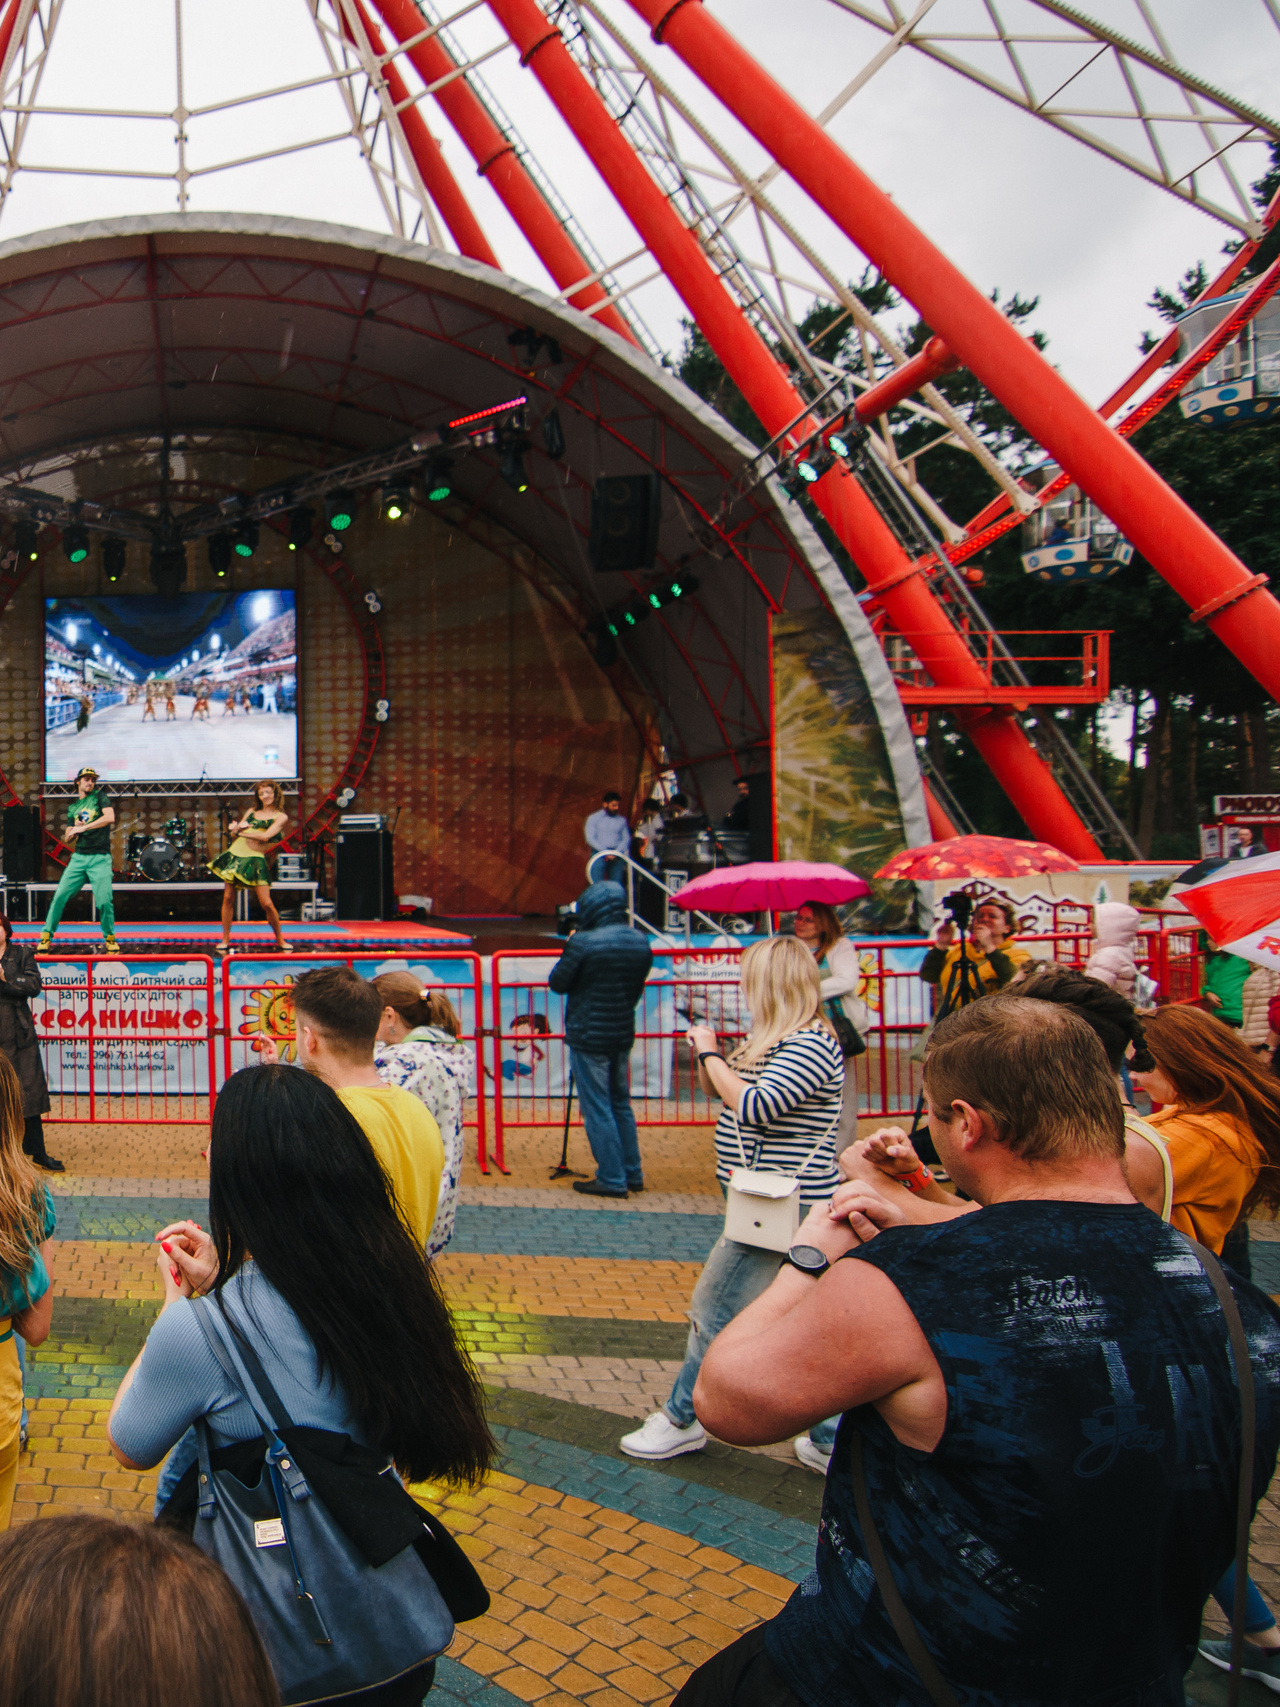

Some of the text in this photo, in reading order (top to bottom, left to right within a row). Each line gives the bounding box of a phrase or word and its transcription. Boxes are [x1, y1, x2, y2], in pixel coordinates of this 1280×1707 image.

[40, 974, 87, 987] кращий
[100, 975, 128, 985] місті
[132, 975, 185, 987] дитячий
[59, 990, 182, 1003] запрошує усіх діток
[116, 1050, 165, 1060] 761-44-62
